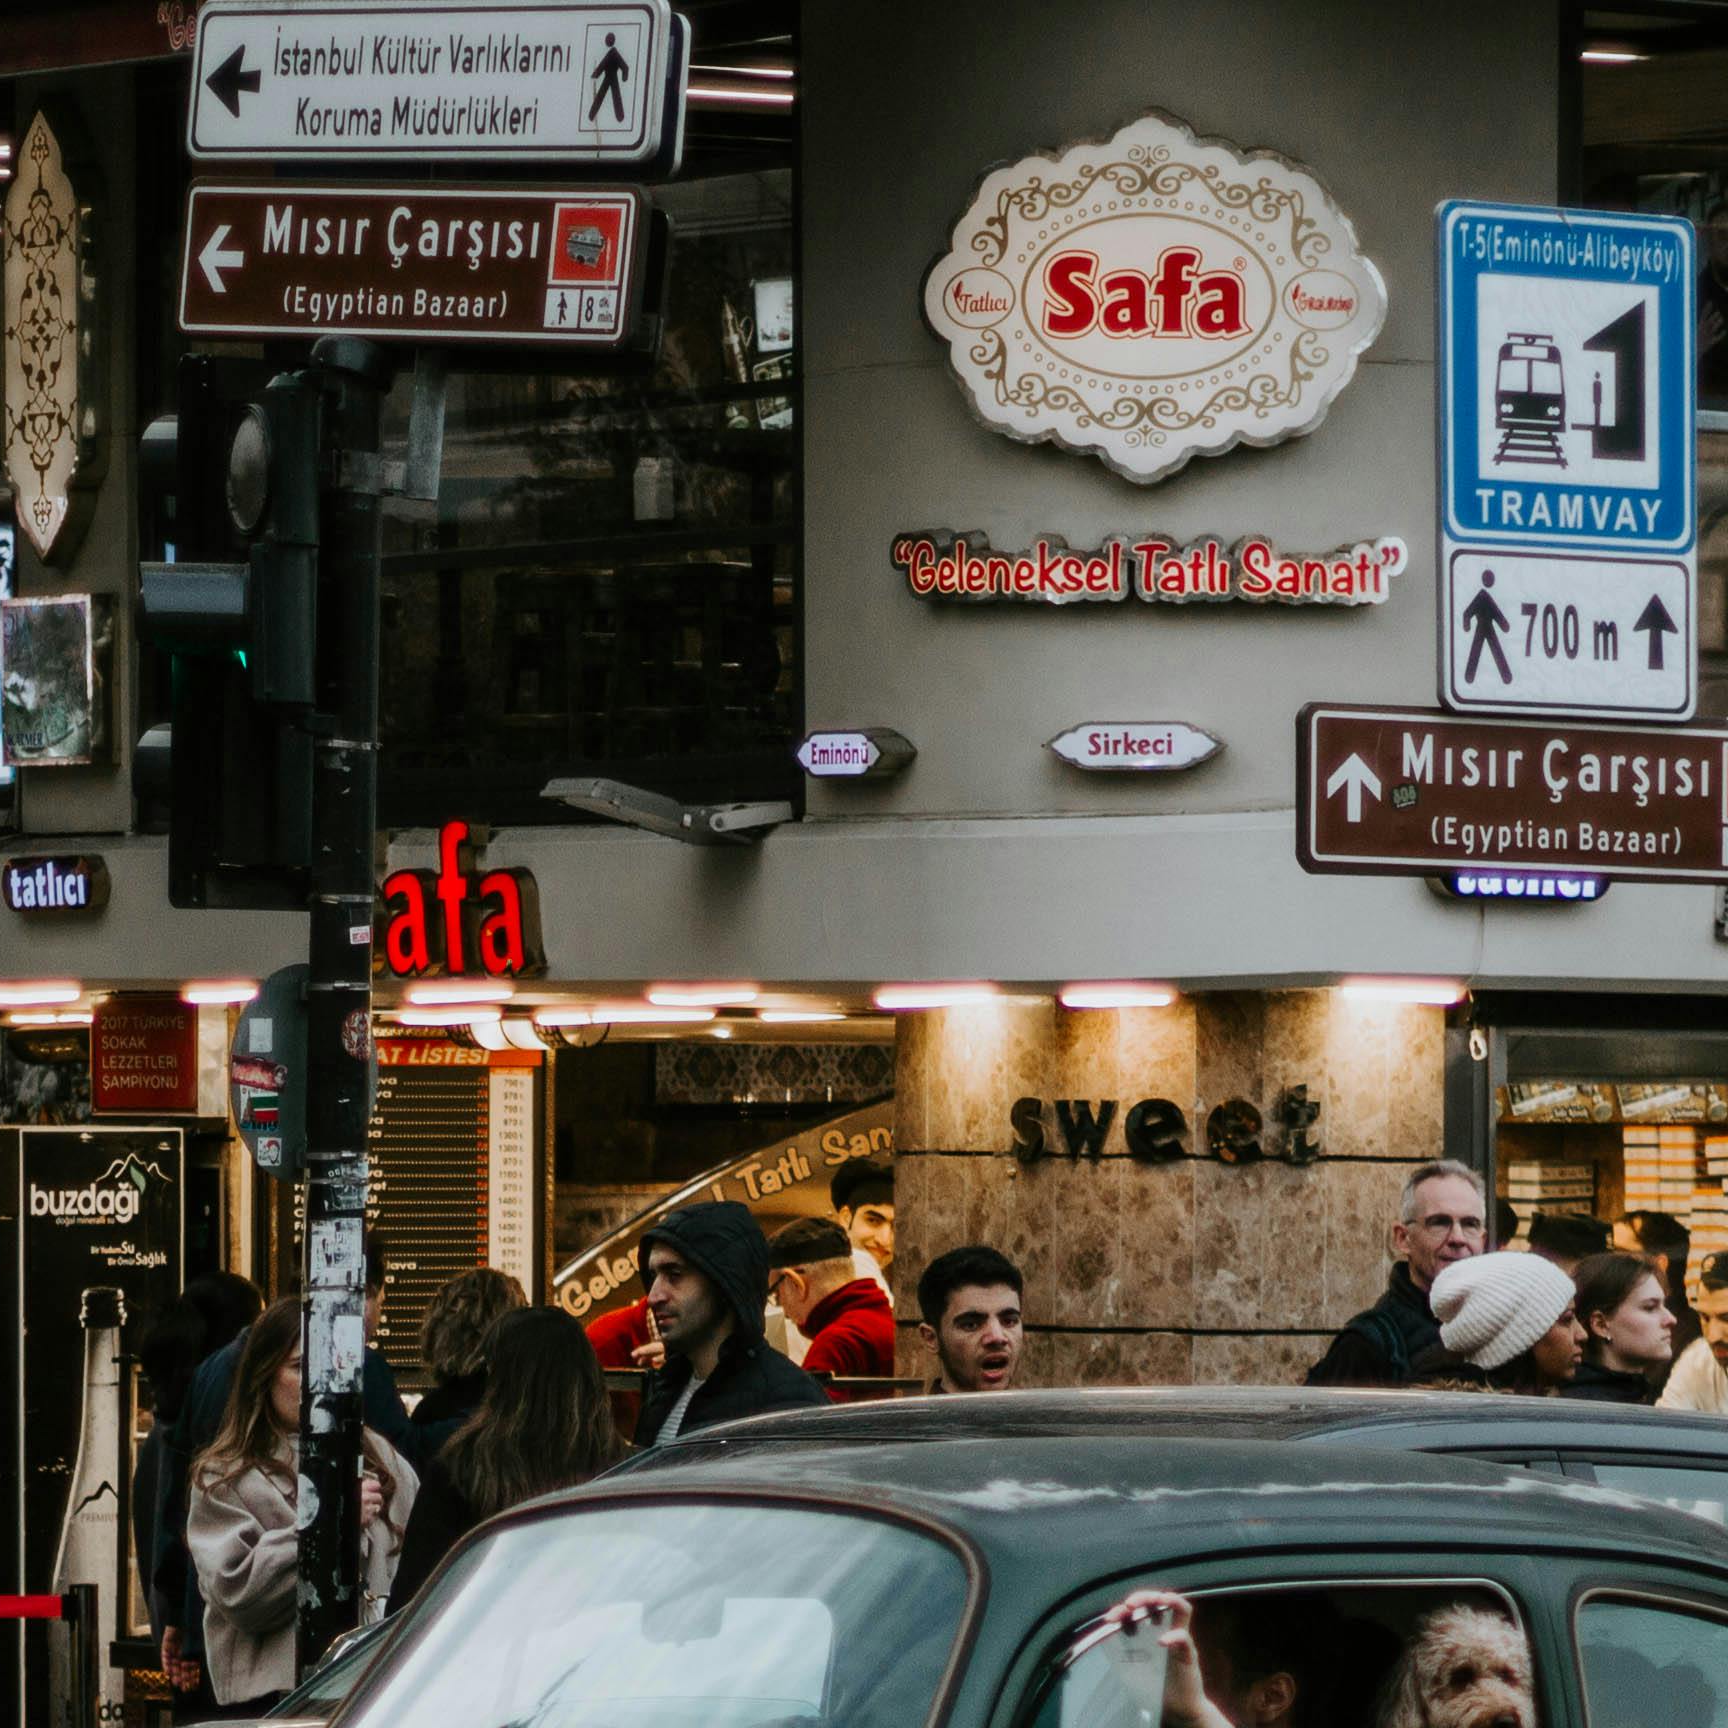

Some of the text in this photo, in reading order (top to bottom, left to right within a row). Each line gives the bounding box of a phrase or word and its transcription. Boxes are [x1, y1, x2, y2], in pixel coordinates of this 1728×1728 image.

[273, 26, 571, 77] İstanbul Kültür Varlıklarını
[296, 97, 538, 136] Koruma Müdürlükleri
[263, 204, 541, 269] Mısır Çarşısı
[283, 286, 507, 322] (Egyptian Bazaar)
[585, 296, 594, 322] 8
[1042, 246, 1252, 339] Safa
[1475, 489, 1663, 533] TRAMVAY
[1134, 541, 1229, 595] Tatlı
[1521, 603, 1618, 661] 700 m
[810, 741, 869, 766] Eminönü
[1087, 732, 1174, 756] Sirkeci
[1402, 732, 1710, 807] Mısır Çarşısı
[1431, 816, 1682, 856] (Egyptian Bazaar)
[10, 862, 86, 908] tatlıcı
[385, 820, 526, 976] afa
[101, 1015, 127, 1030] 2017
[102, 1035, 146, 1050] SOKAK
[1009, 1083, 1322, 1167] sweet
[735, 1147, 812, 1200] Tatlı
[30, 1181, 139, 1223] buzdağı
